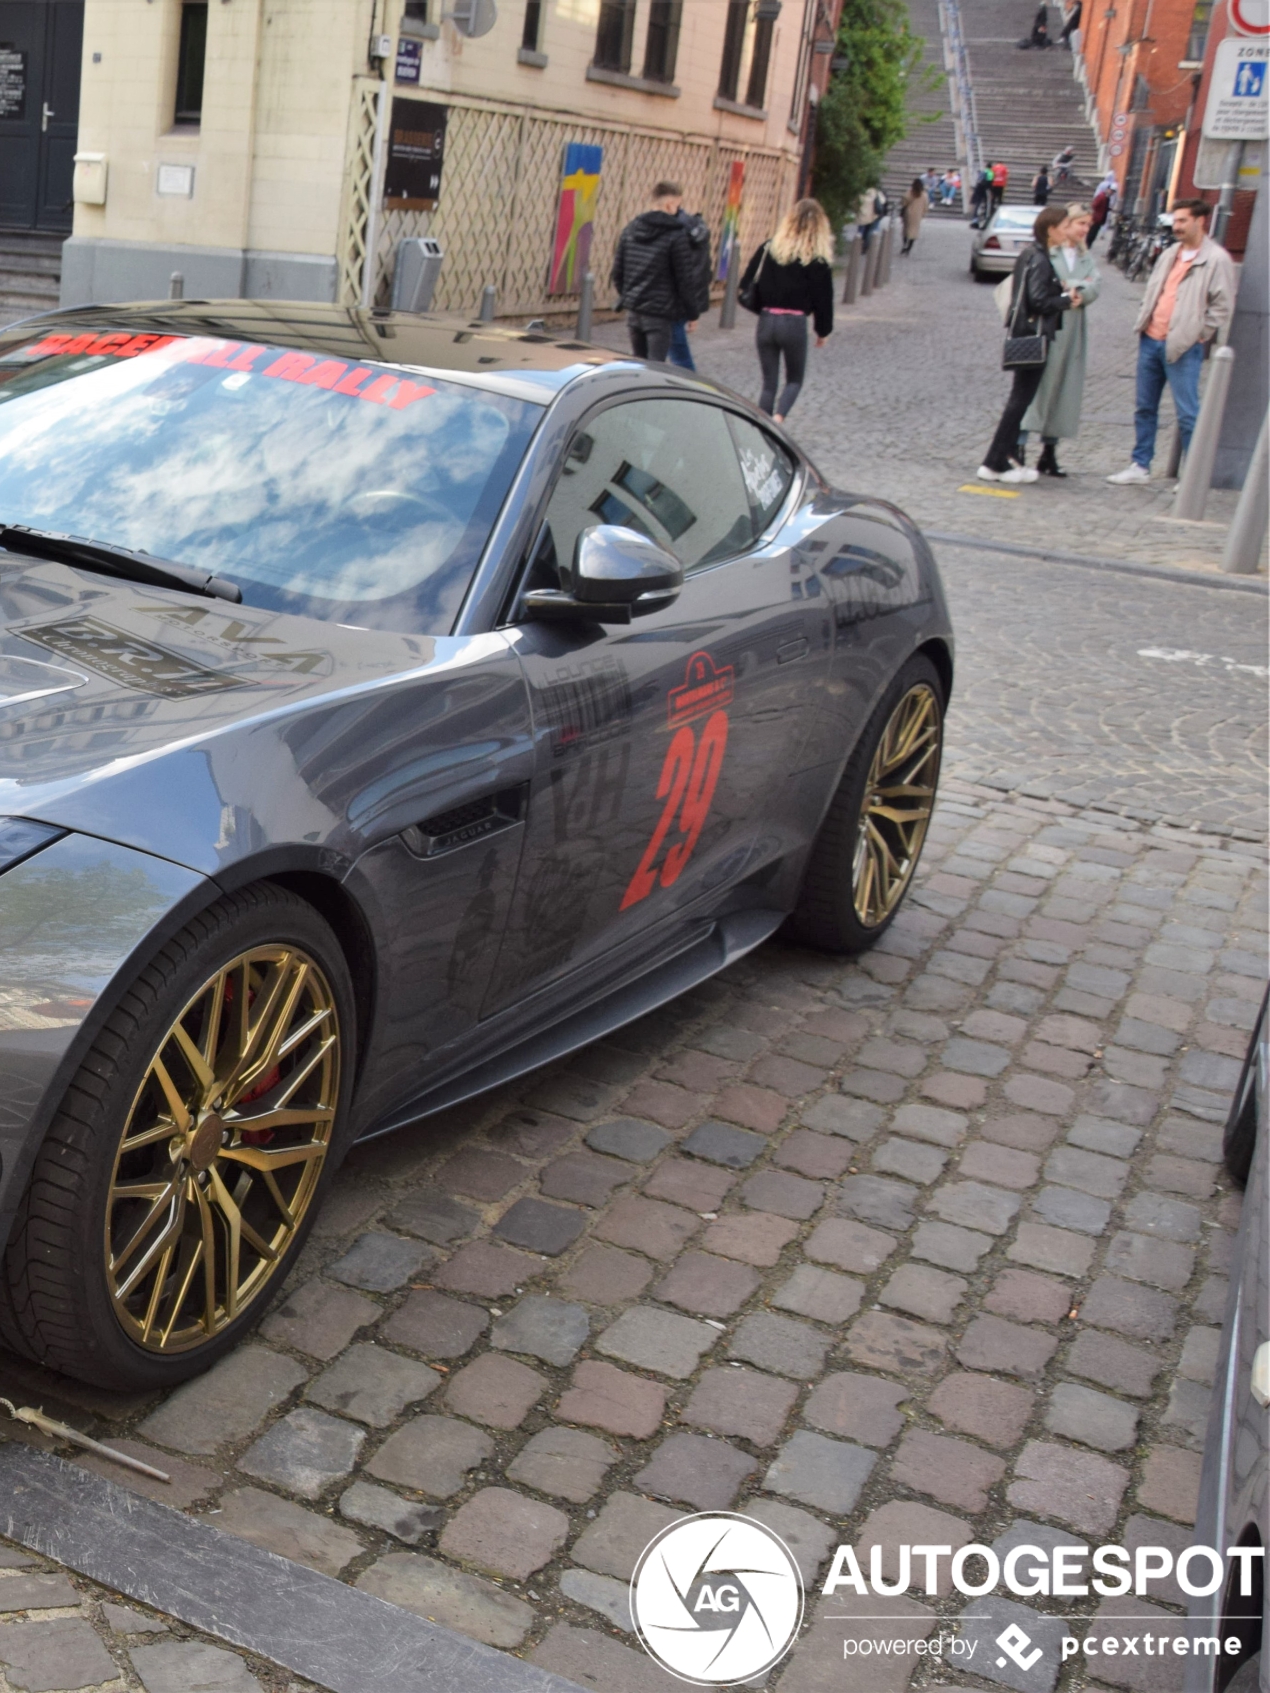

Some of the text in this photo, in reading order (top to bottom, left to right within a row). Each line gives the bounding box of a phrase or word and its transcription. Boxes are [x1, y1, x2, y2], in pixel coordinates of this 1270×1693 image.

[262, 352, 437, 411] RALLY
[445, 822, 492, 846] JAGUAR
[618, 709, 729, 913] 29
